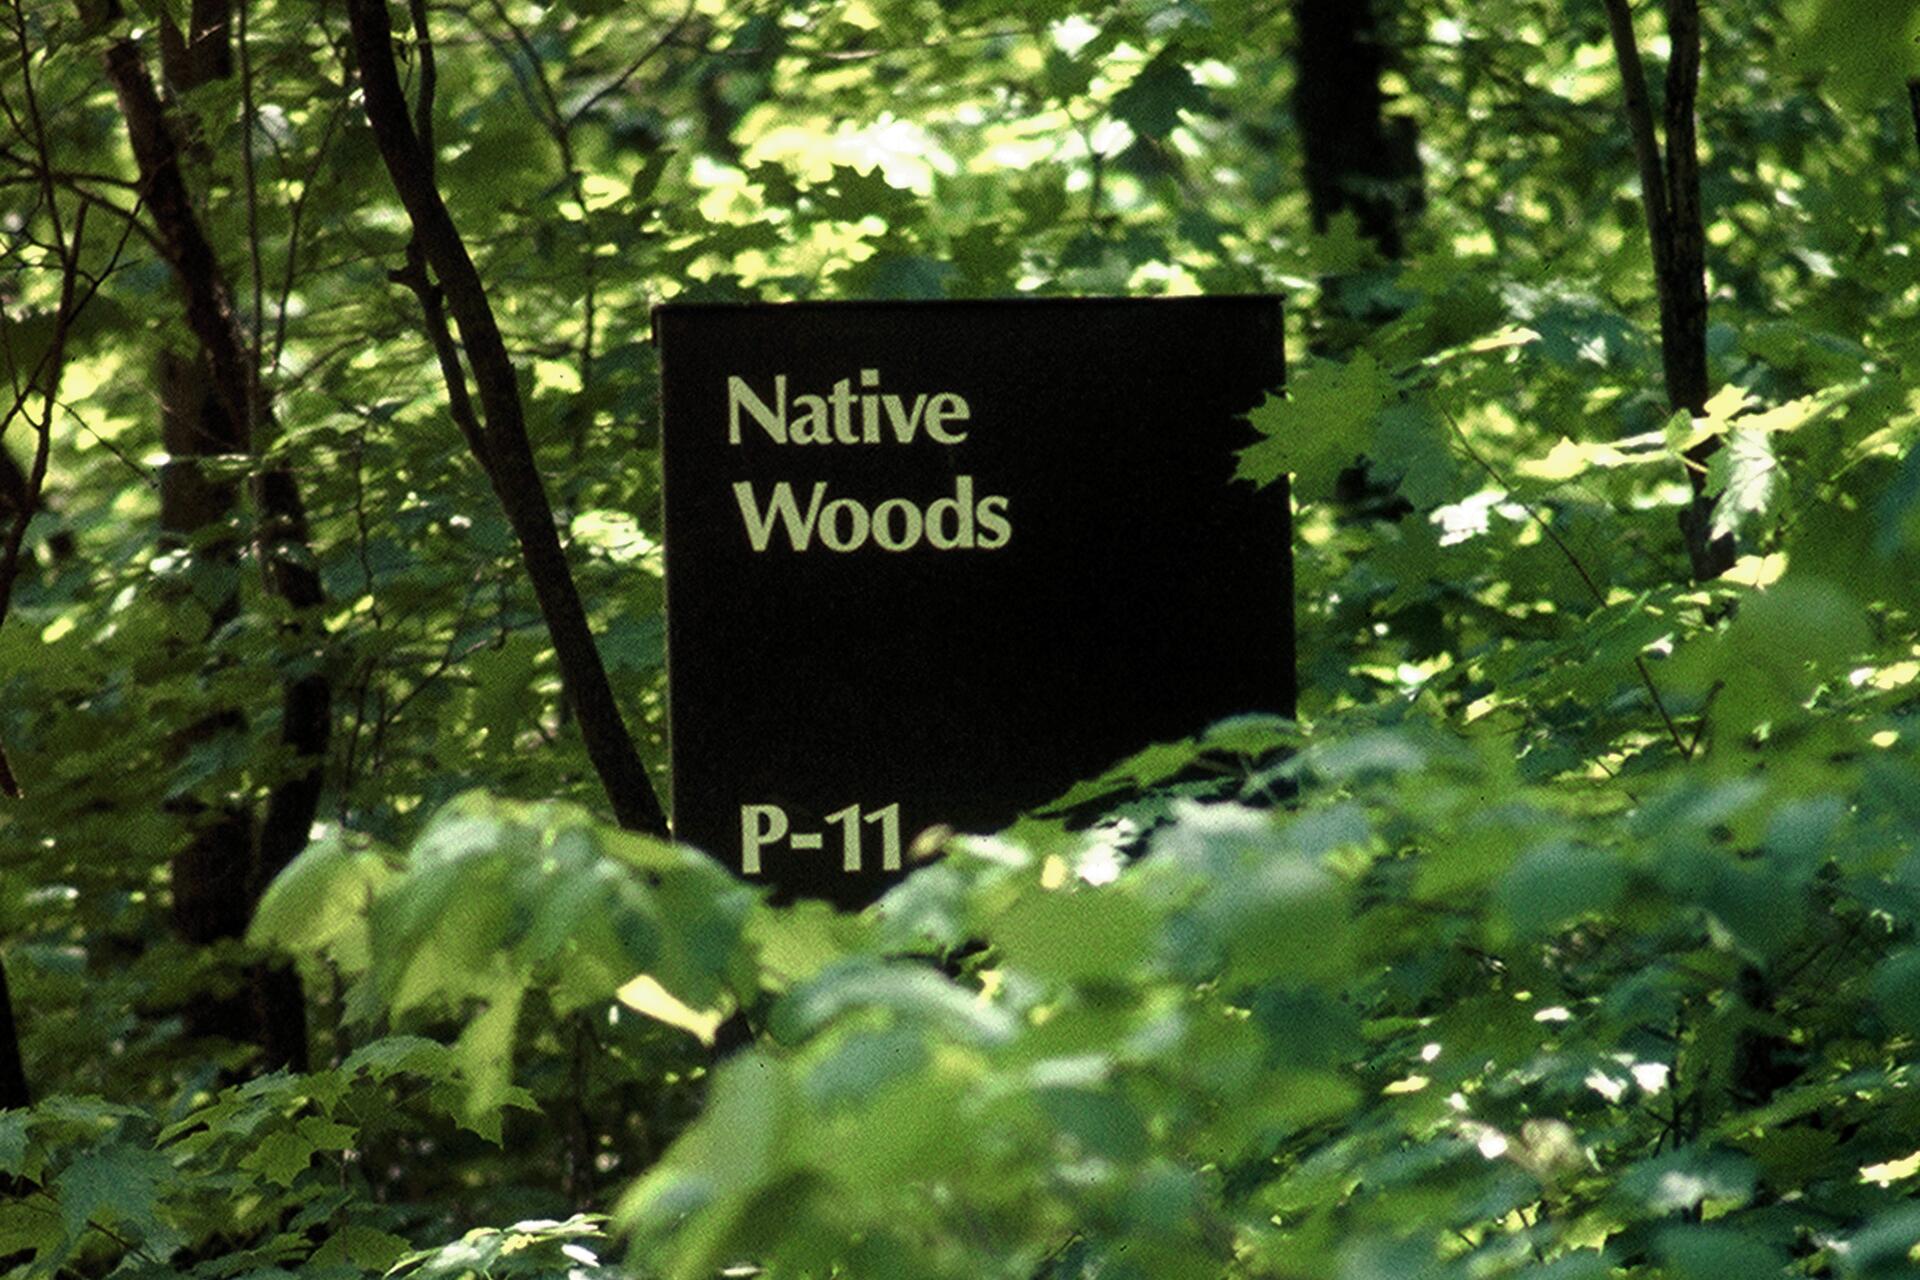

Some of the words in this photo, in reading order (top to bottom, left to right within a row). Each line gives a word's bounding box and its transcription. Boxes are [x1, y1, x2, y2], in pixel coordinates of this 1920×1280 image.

[728, 369, 971, 445] Native
[732, 475, 1012, 553] Woods
[741, 802, 901, 874] P-11
